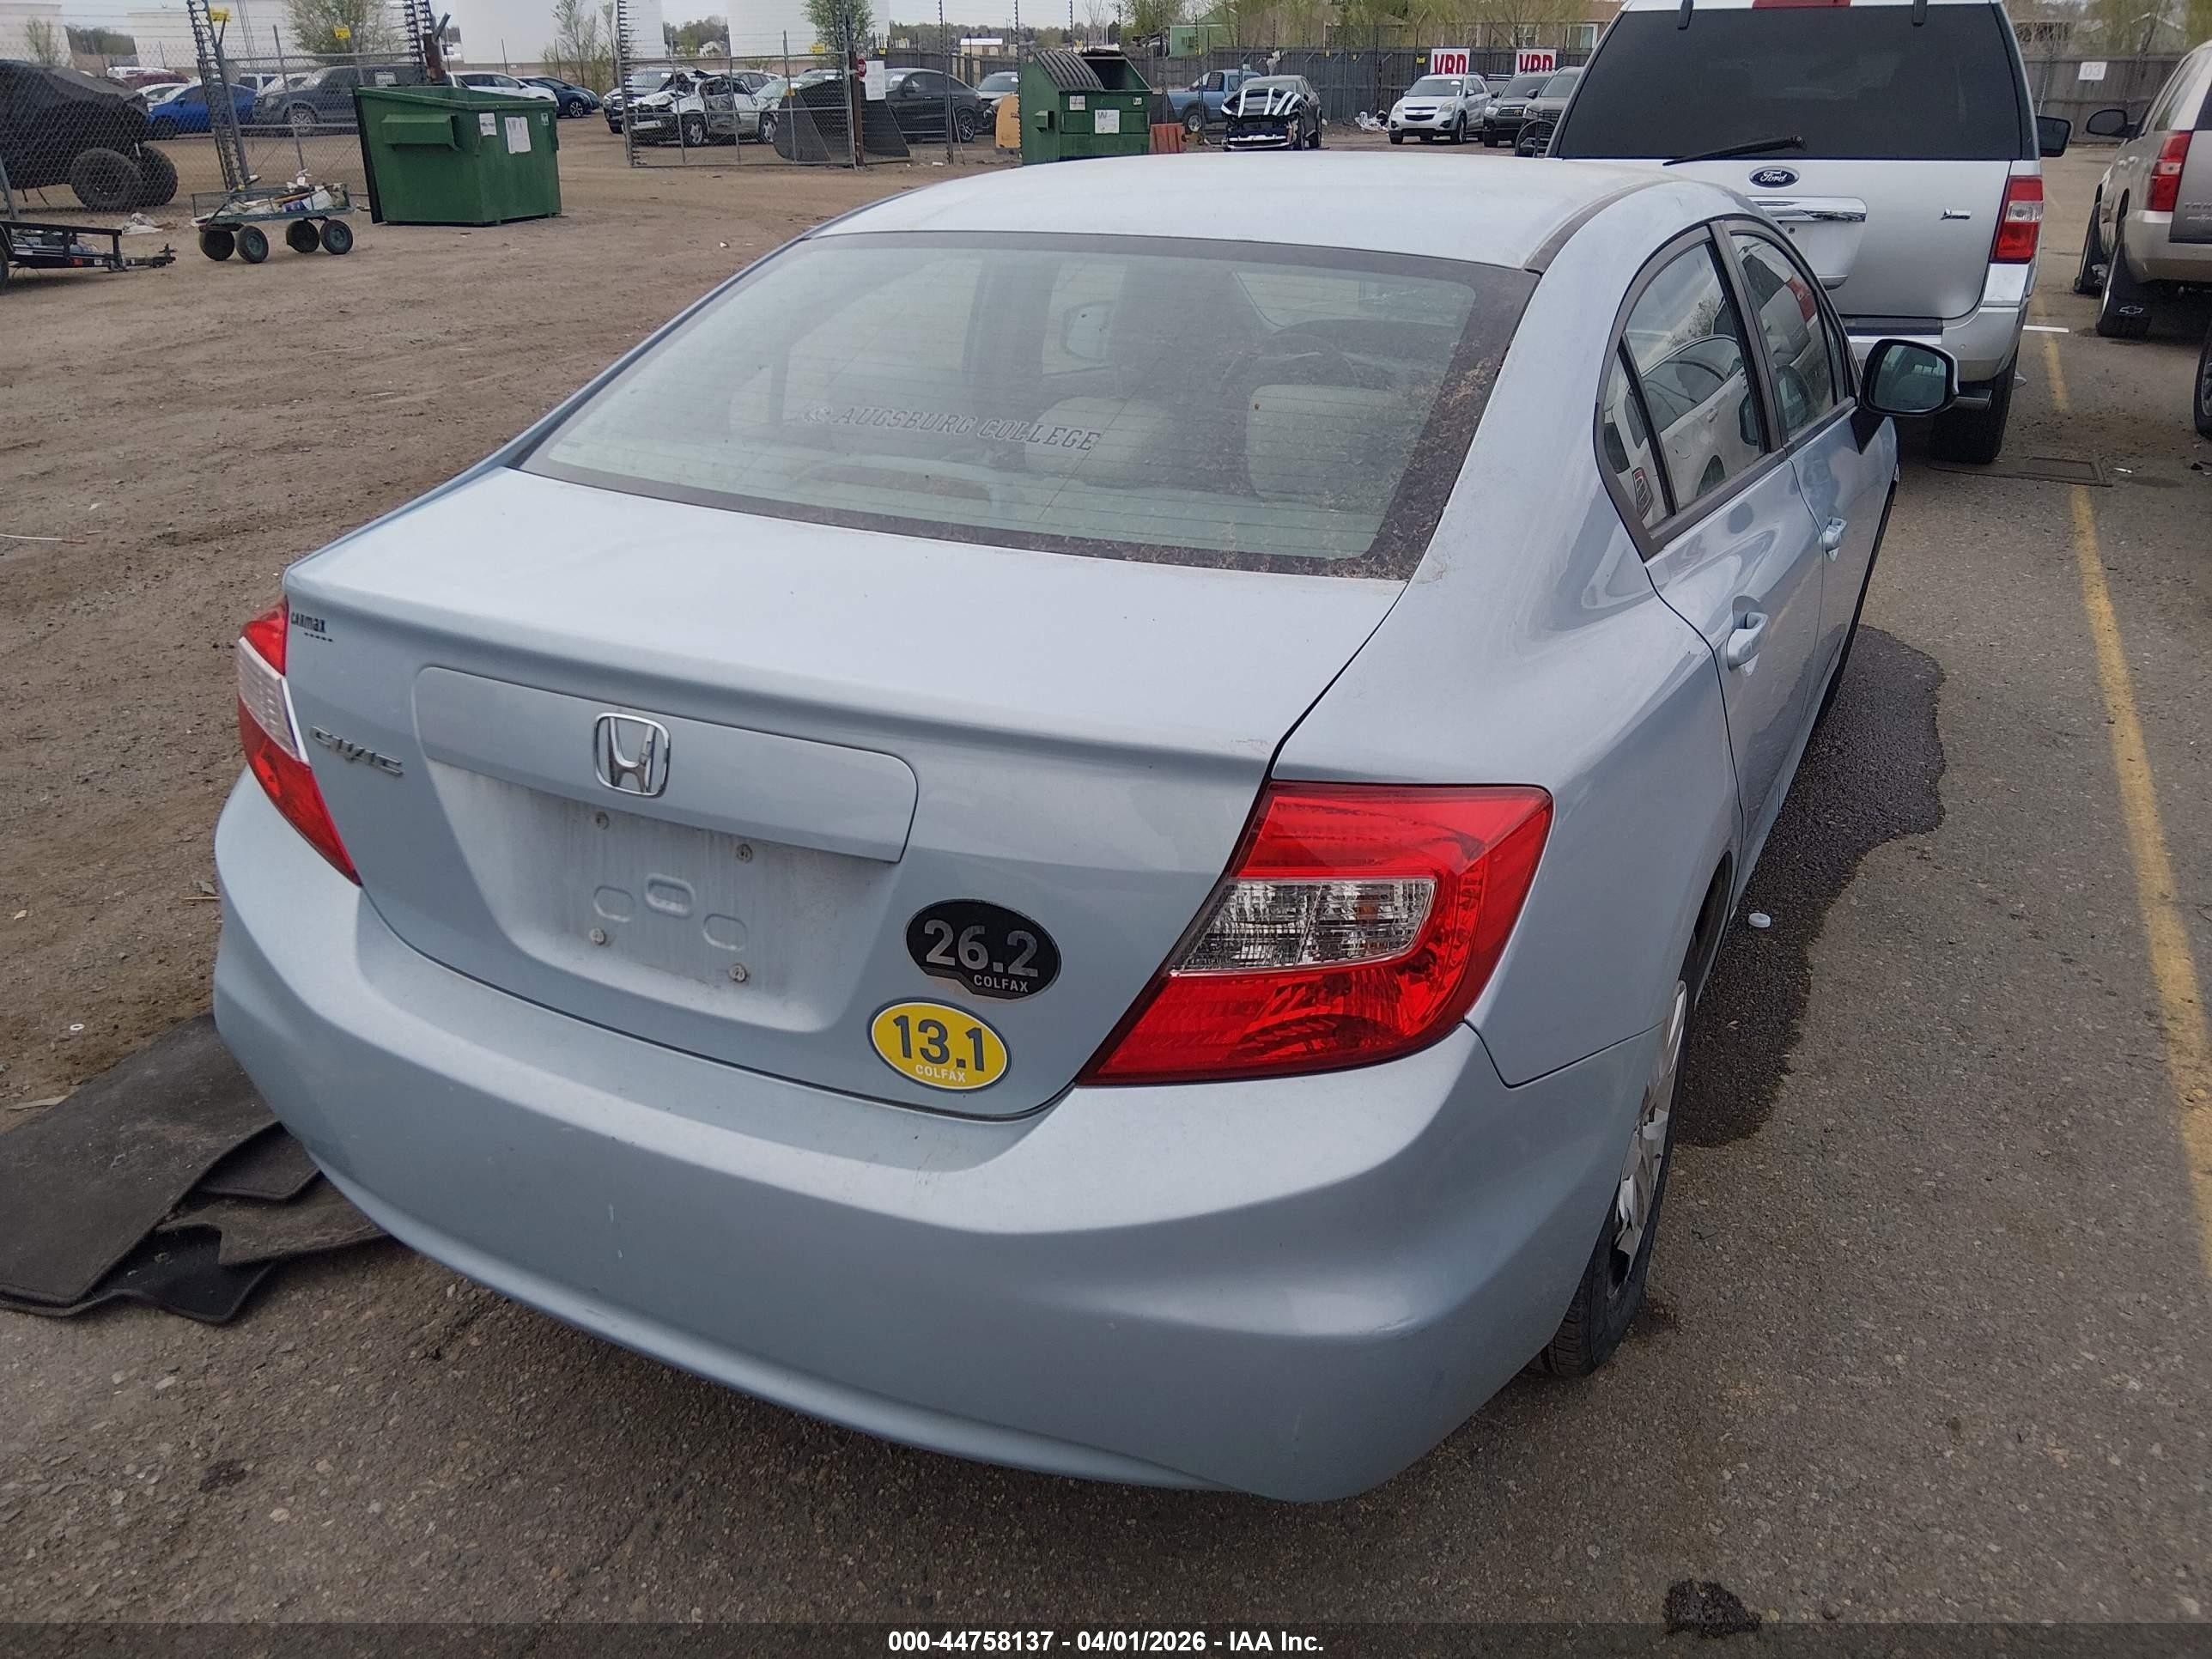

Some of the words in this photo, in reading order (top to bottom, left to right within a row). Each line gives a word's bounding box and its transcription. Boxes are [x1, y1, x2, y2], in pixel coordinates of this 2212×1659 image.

[1759, 170, 1788, 183] Ford
[832, 407, 976, 434] AUGSBURG
[978, 419, 1102, 451] COLLEGE
[309, 726, 404, 777] CIVIC
[923, 919, 1039, 978] 26.2
[973, 975, 1030, 993] COLFAX
[892, 1014, 986, 1073] 13.1
[915, 1064, 967, 1084] COLFAX
